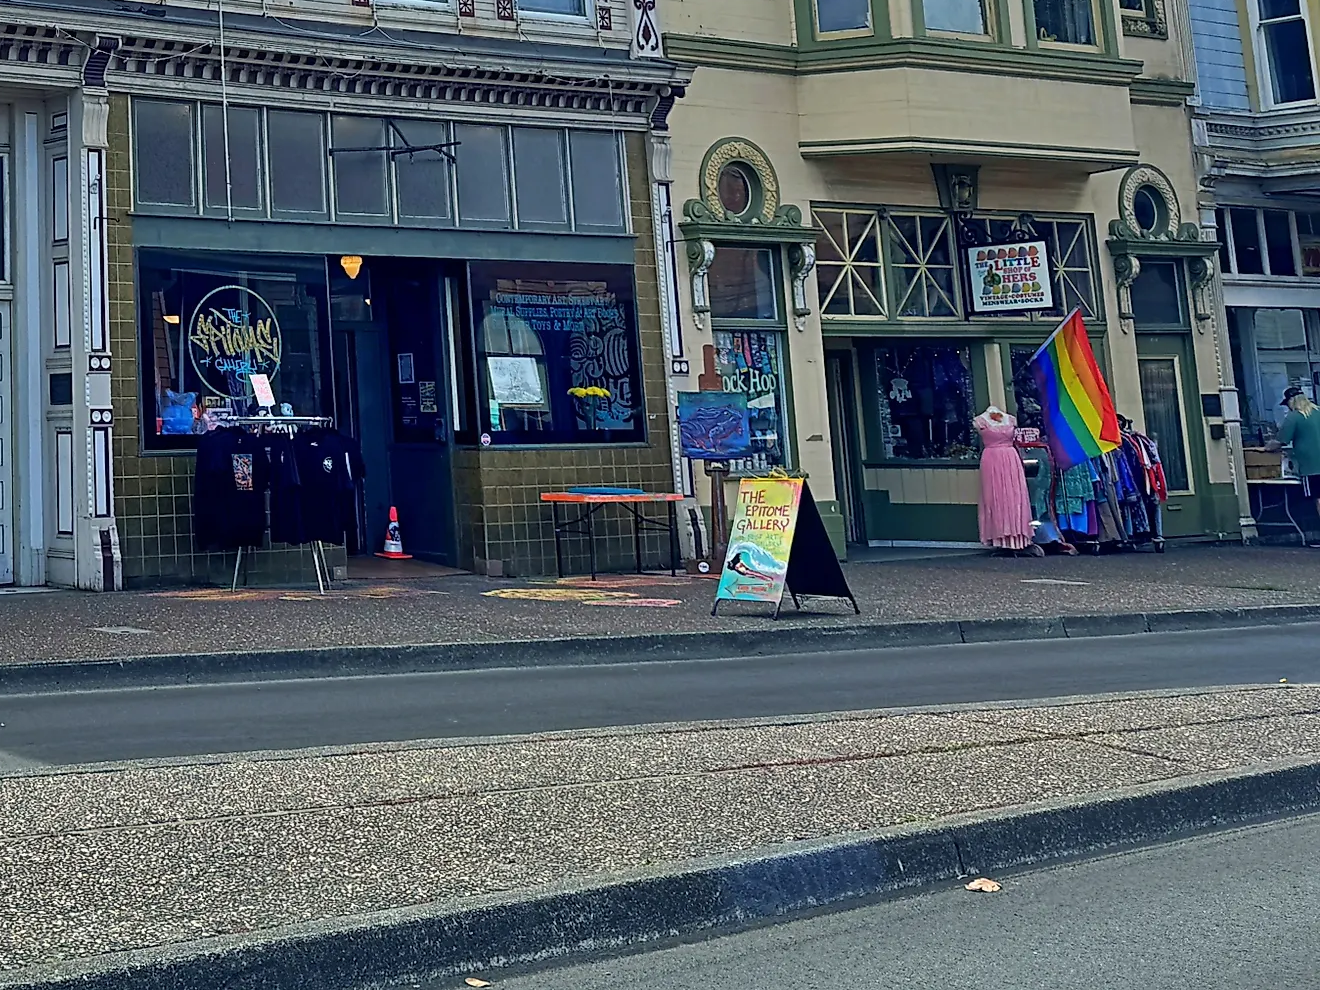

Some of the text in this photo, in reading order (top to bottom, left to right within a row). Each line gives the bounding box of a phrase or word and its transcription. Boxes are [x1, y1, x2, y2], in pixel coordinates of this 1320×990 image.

[994, 256, 1040, 270] LITTLE
[1002, 272, 1037, 283] HERS
[222, 308, 242, 323] THE
[722, 369, 748, 392] ock
[741, 490, 766, 504] THE
[745, 505, 790, 517] EPITOME
[737, 518, 790, 534] GALLERY
